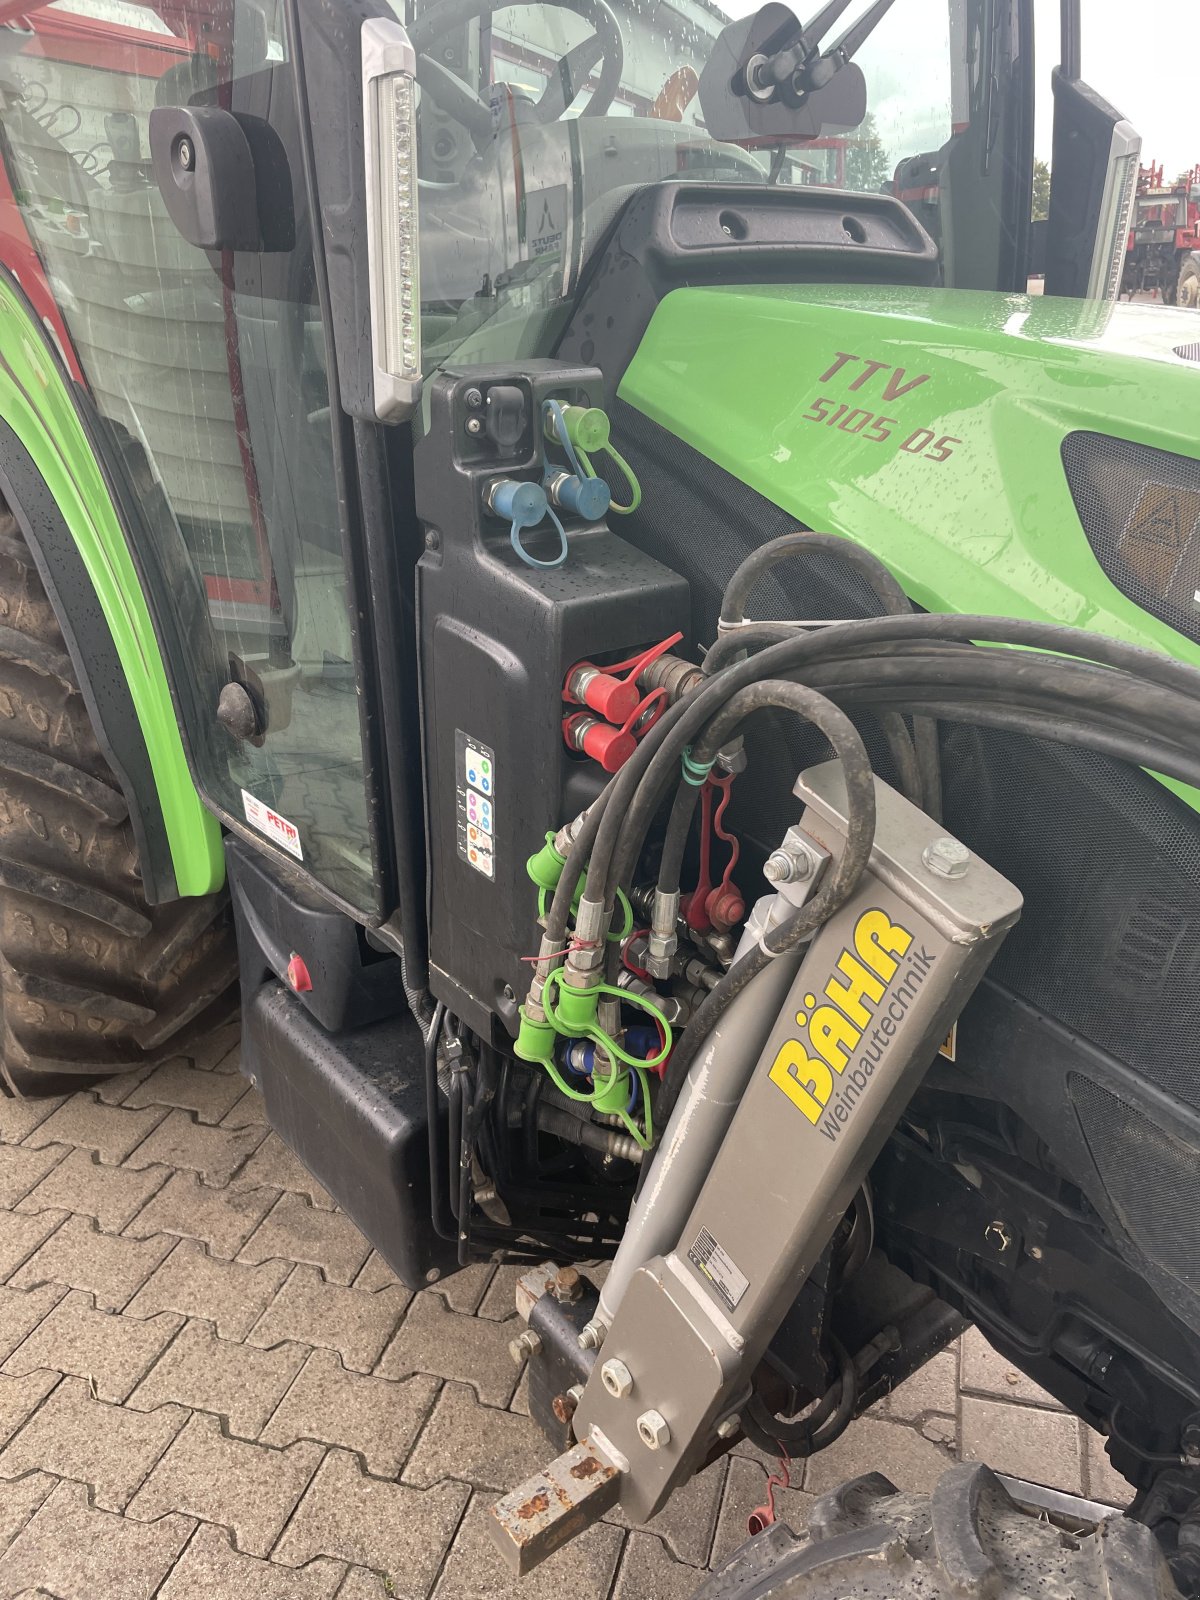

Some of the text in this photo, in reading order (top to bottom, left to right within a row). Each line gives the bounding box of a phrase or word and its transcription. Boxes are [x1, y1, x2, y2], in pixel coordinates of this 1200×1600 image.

[819, 352, 931, 401] TTV
[802, 398, 898, 442] 5105
[266, 810, 296, 838] PETRI
[767, 907, 915, 1127] BÄHR
[819, 945, 936, 1142] Weinbautechnik
